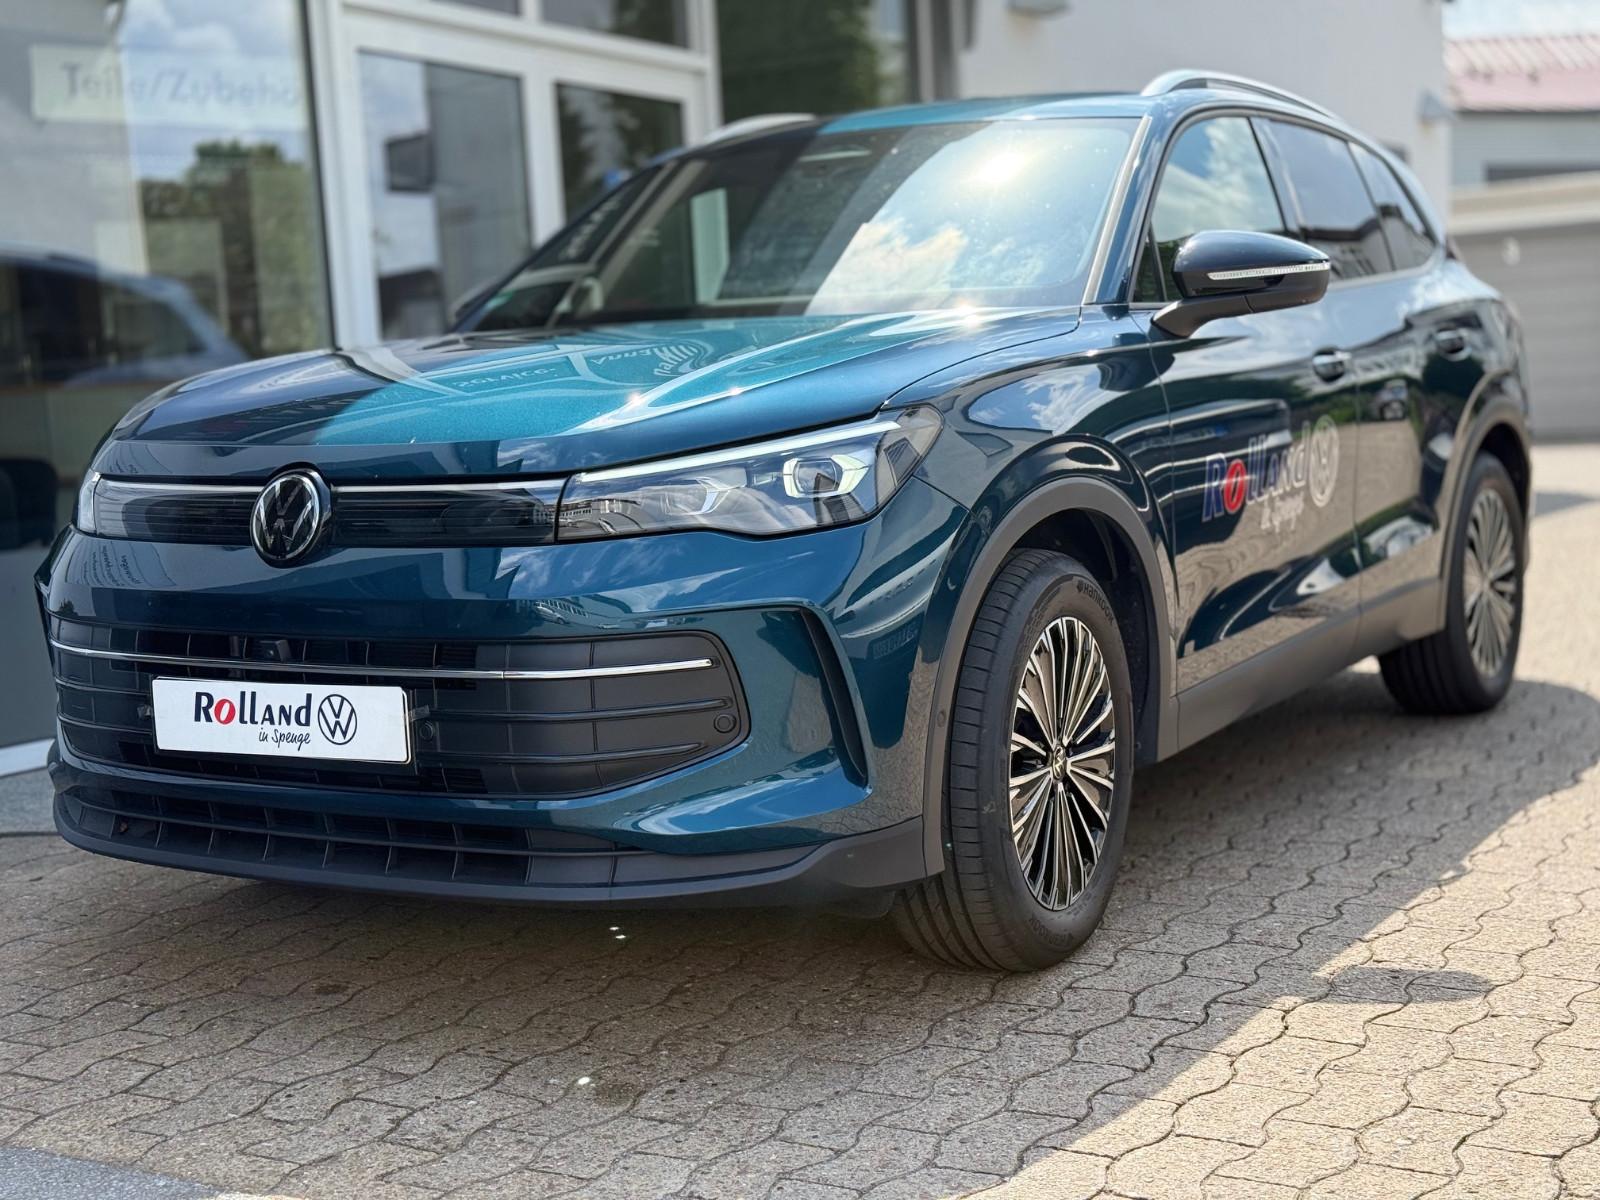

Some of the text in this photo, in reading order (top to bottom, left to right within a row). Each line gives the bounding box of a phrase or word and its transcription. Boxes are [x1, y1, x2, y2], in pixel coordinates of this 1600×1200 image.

[317, 693, 358, 746] VW
[258, 727, 311, 751] in Spenge
